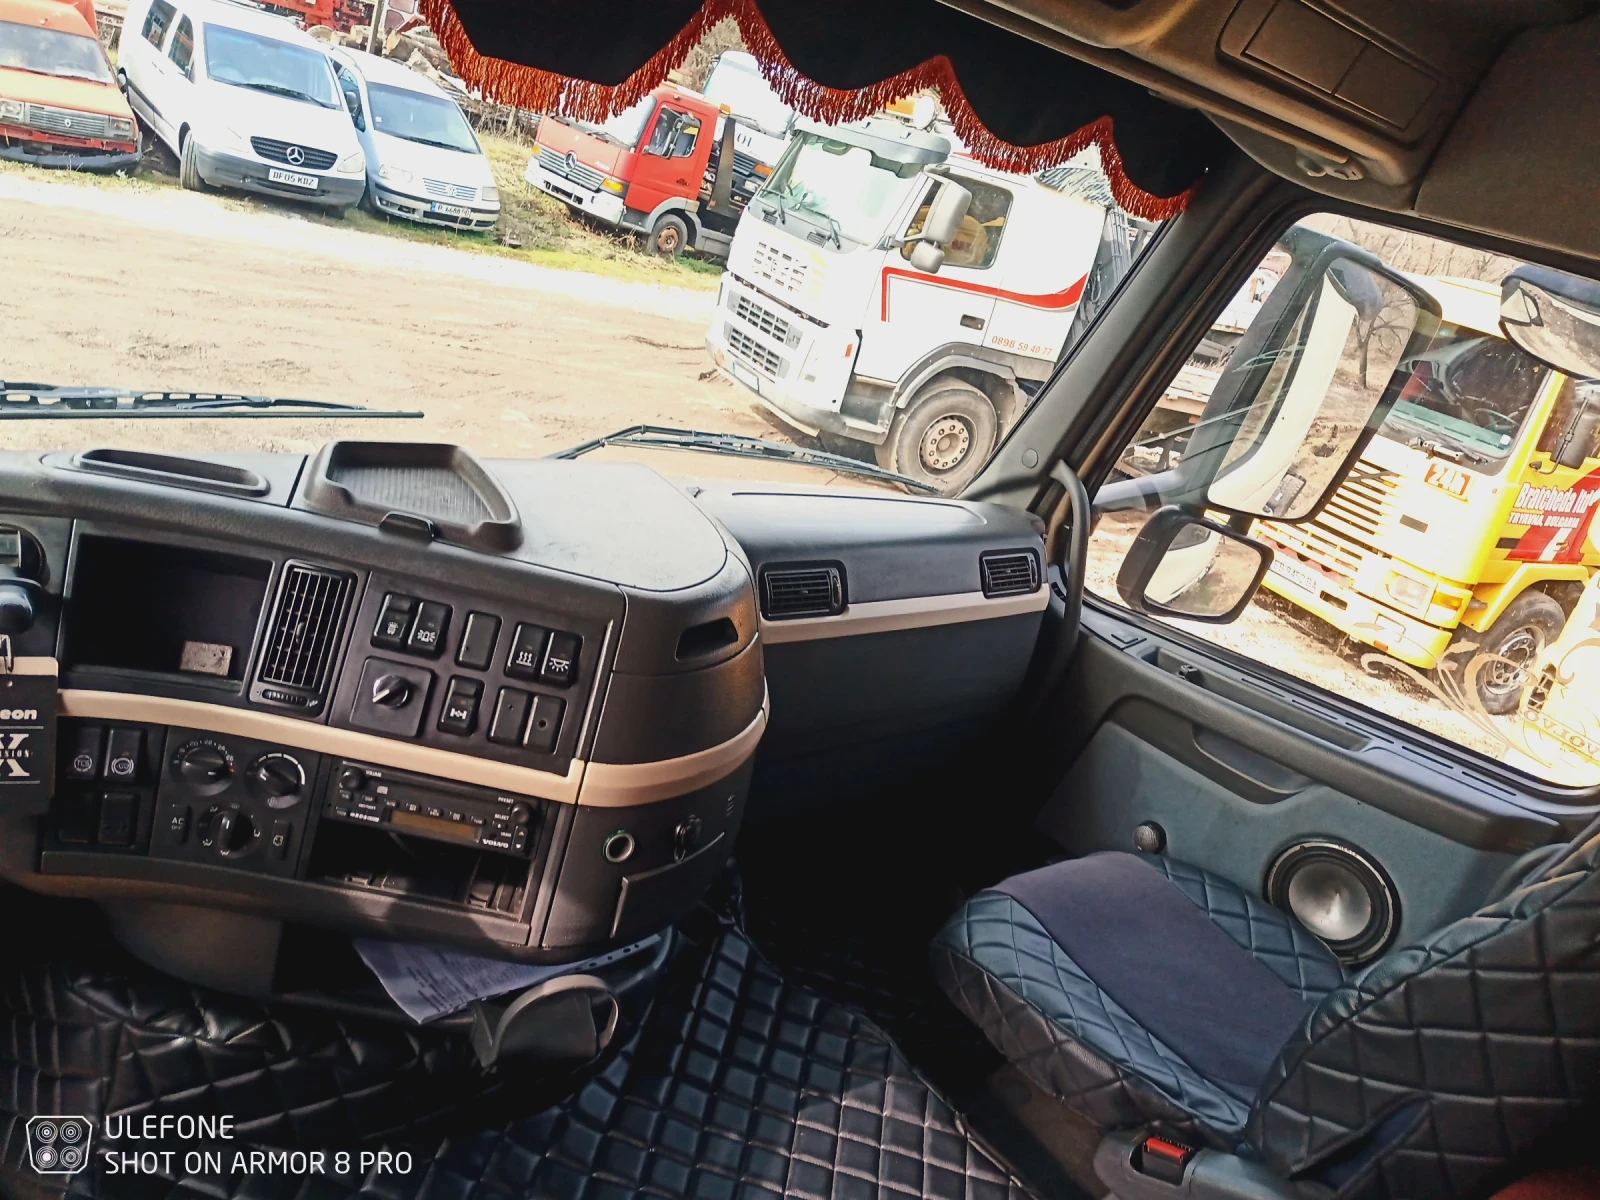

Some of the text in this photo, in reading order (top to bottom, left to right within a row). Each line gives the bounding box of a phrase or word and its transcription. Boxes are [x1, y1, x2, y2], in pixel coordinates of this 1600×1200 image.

[991, 335, 1053, 356] 0898 59 40 77
[0, 709, 38, 720] eon
[482, 838, 509, 849] VOLVO
